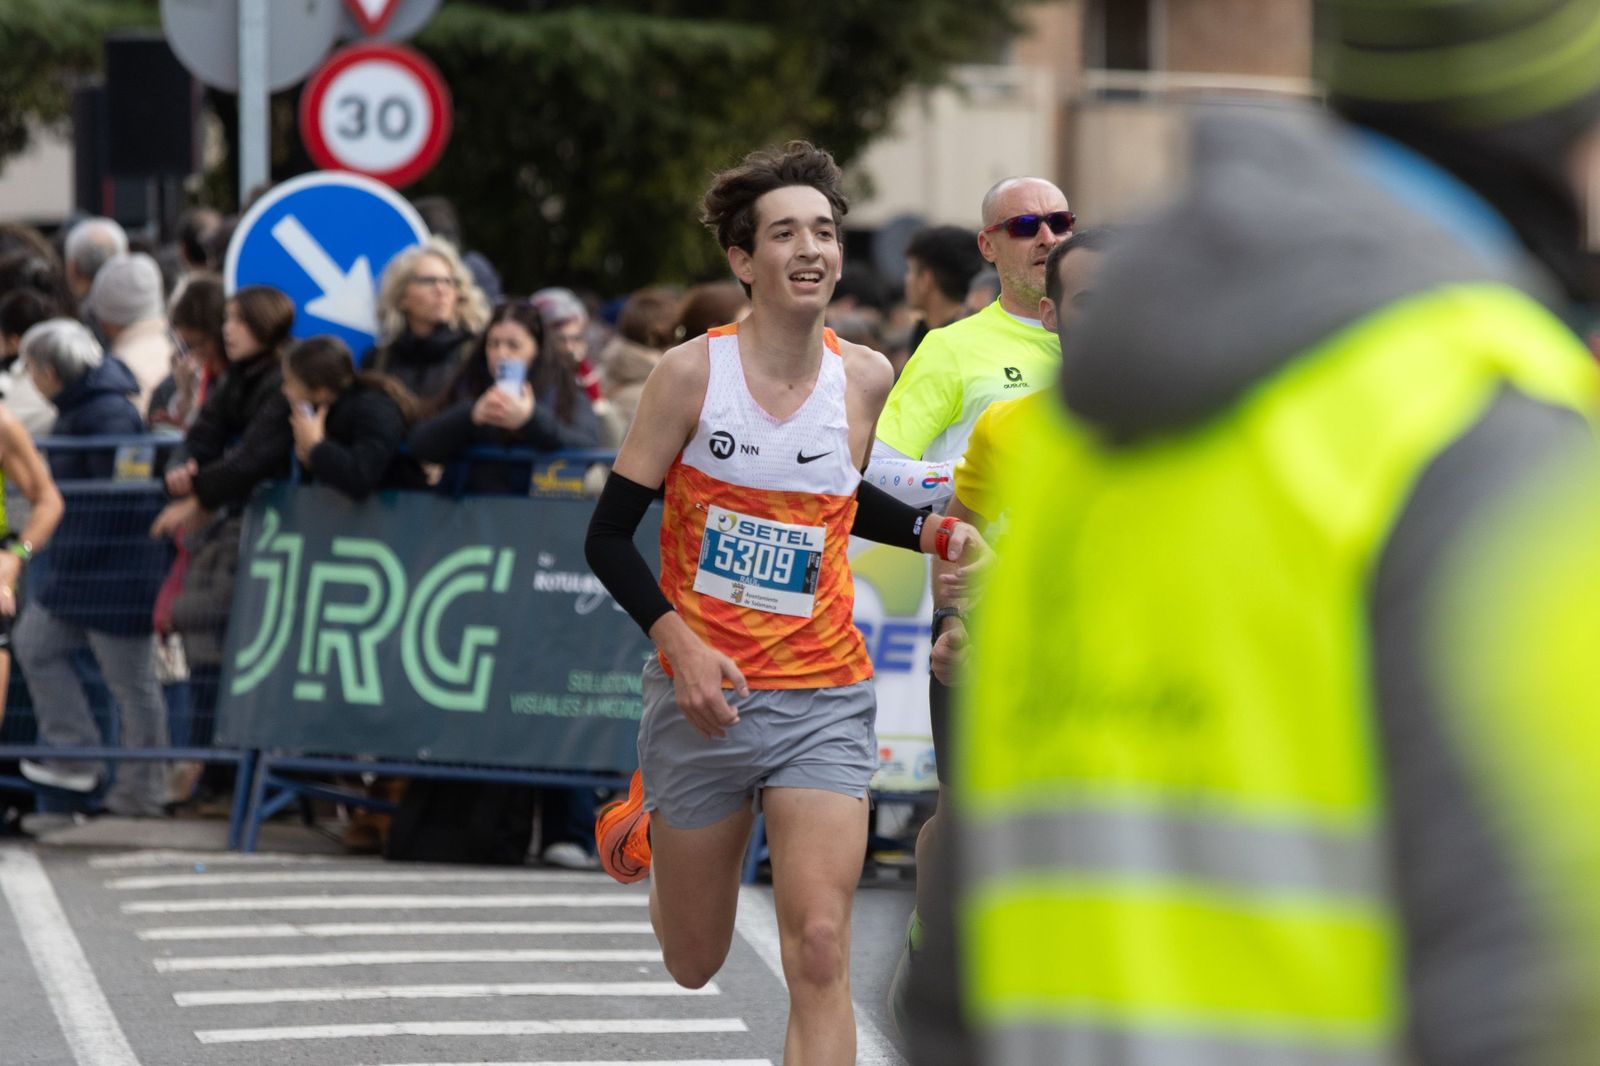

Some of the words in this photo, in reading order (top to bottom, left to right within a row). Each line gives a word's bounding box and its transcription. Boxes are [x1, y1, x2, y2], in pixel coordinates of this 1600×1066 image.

[336, 94, 413, 142] 30
[740, 444, 760, 456] NN
[738, 520, 813, 546] SETEL
[714, 534, 796, 584] 5309
